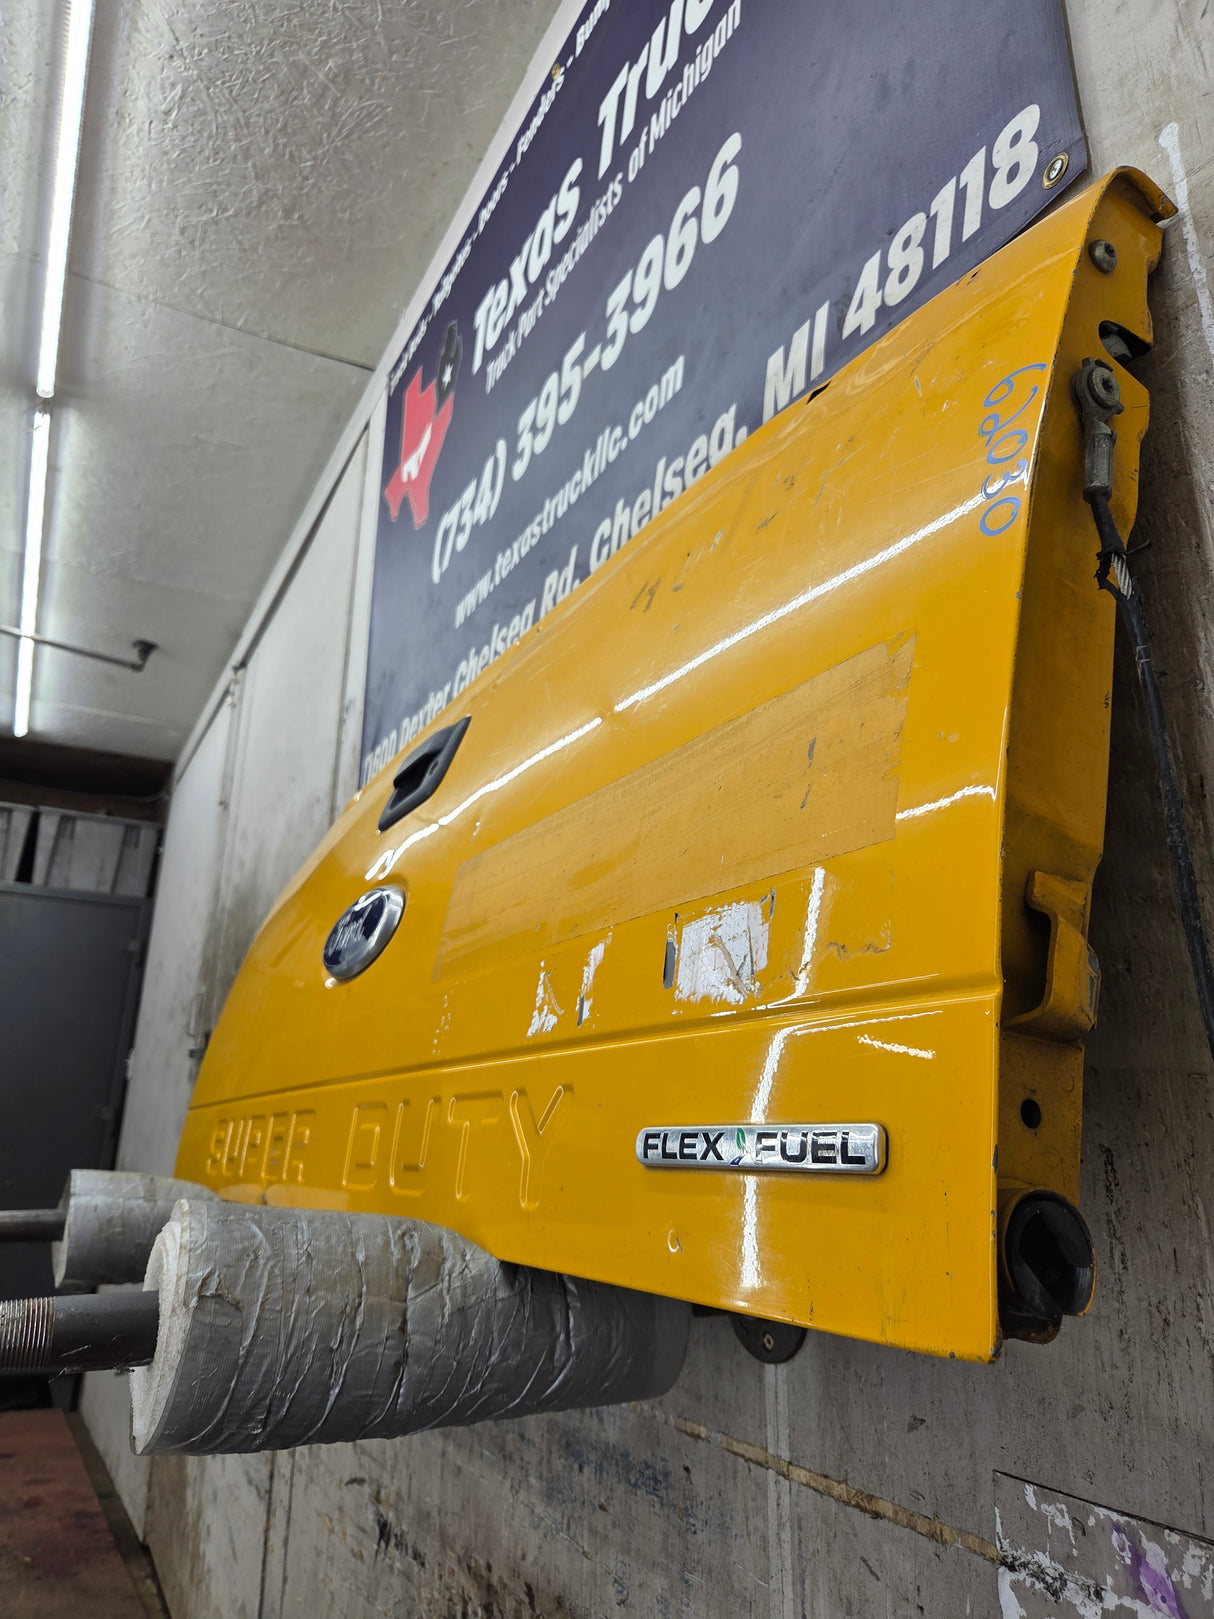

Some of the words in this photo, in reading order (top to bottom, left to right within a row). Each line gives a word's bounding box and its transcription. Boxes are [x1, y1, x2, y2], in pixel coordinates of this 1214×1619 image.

[472, 157, 583, 376] Texas
[485, 329, 516, 395] Truck
[516, 287, 546, 350] Part
[544, 171, 623, 306] Specialists
[628, 125, 649, 183] of
[649, 0, 742, 155] Michigan
[431, 437, 507, 585] (734)
[512, 131, 743, 482] 395-3966
[453, 597, 537, 699] Chelsea
[762, 300, 830, 426] MI
[841, 103, 1041, 341] 48118
[455, 355, 685, 630] www.texastruckllc.com
[342, 1083, 575, 1210] DUTY
[643, 1131, 726, 1161] FLEX
[756, 1129, 867, 1166] FUEL
